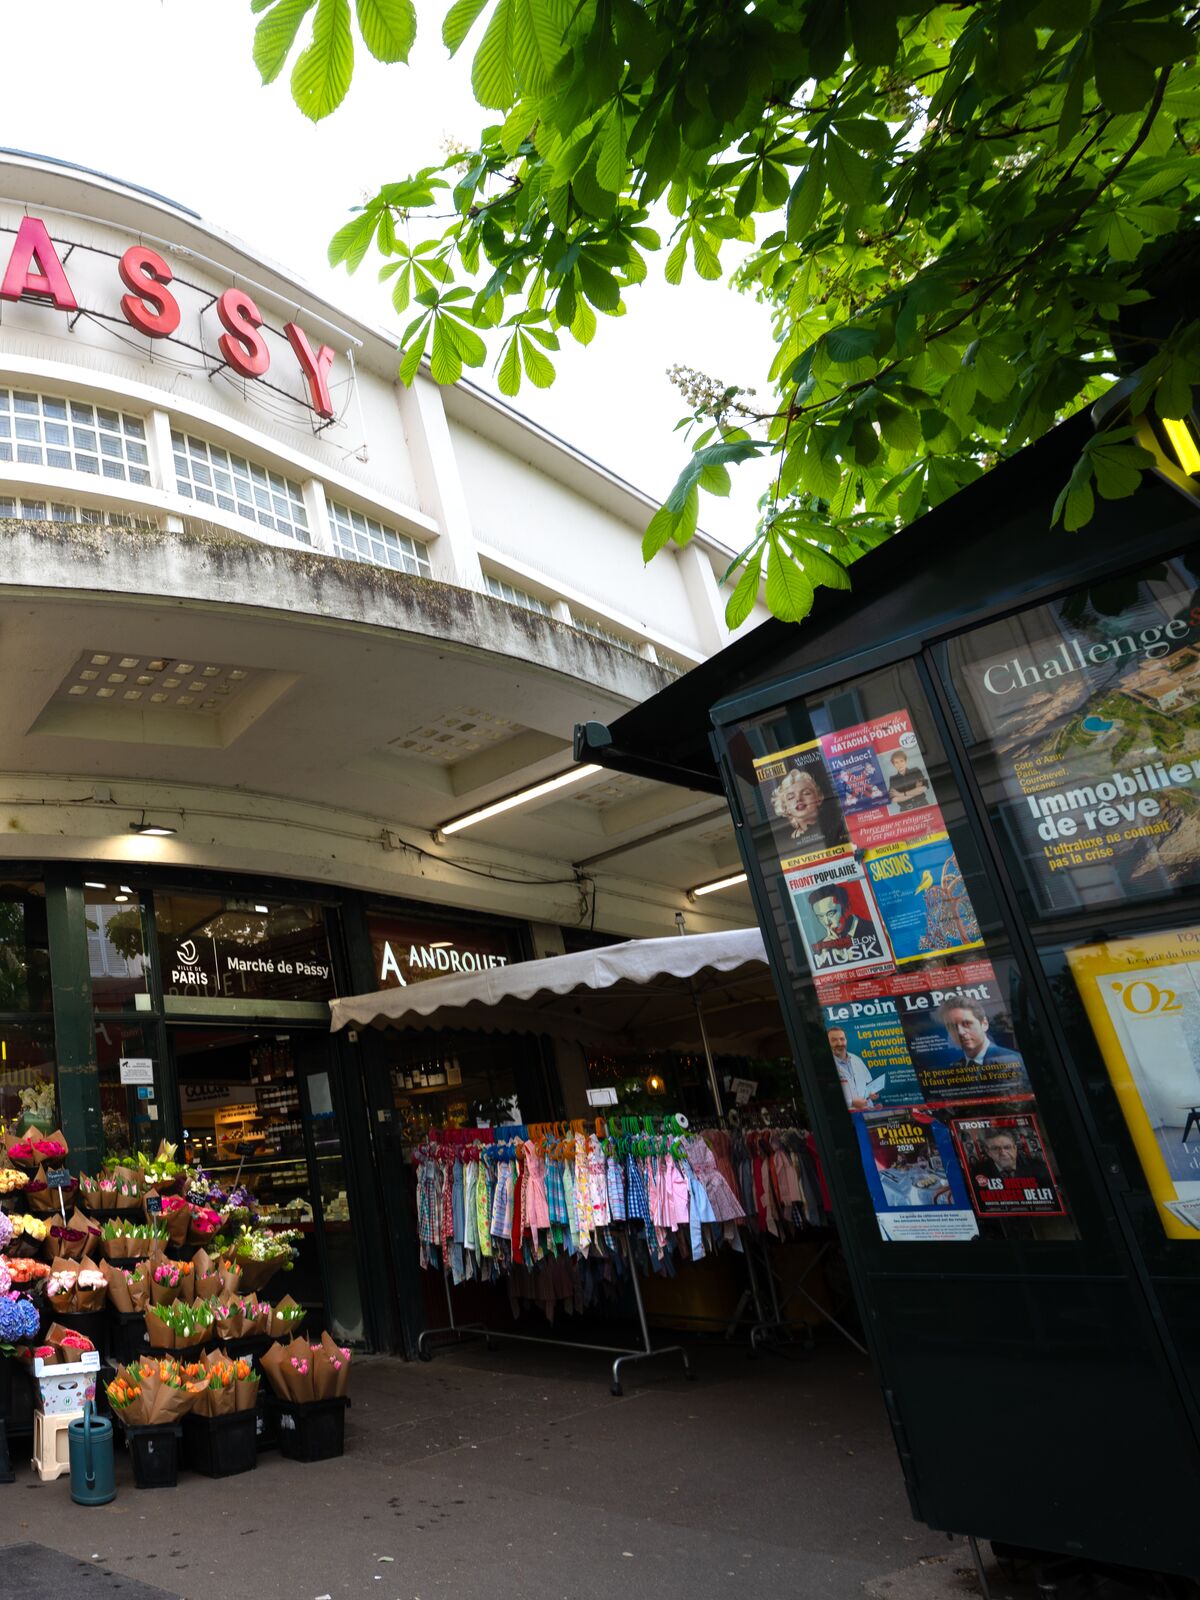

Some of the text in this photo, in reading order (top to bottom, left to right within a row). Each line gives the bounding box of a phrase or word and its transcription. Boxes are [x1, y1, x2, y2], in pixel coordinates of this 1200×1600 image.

[830, 721, 907, 753] NATACHA POLONY
[844, 727, 871, 741] nouvelle
[1014, 752, 1065, 772] Côte d'Azur,
[1017, 768, 1040, 779] Paris,
[1019, 768, 1070, 787] Courchevel,
[1026, 760, 1200, 819] Immobilier
[1038, 797, 1161, 842] de rêve
[1043, 838, 1104, 858] L'ultraluxe
[1106, 833, 1121, 844] ne
[787, 846, 845, 867] EN VENTE ICI
[1048, 846, 1114, 872] pas la crise
[870, 854, 914, 882] SAISONS
[853, 934, 877, 947] ELON
[814, 945, 881, 968] MUSK
[227, 956, 329, 979] Marché de Passy
[171, 970, 208, 985] PARIS
[827, 999, 898, 1022] Le Poin
[903, 994, 930, 1011] Le
[857, 1029, 873, 1040] Les
[861, 1048, 877, 1059] des
[867, 1059, 888, 1069] pour
[931, 1067, 956, 1079] pense
[956, 1065, 980, 1075] savoir
[981, 1062, 1022, 1071] comment
[928, 1076, 945, 1086] faut
[945, 1072, 978, 1086] présider
[979, 1072, 988, 1081] la
[988, 1069, 1017, 1080] France
[876, 1122, 923, 1140] Pudlo
[959, 1120, 991, 1130] FRONT
[888, 1136, 926, 1146] Bistrots
[987, 1177, 1004, 1190] LES
[1023, 1187, 1037, 1201] DE
[1037, 1187, 1054, 1200] LFI
